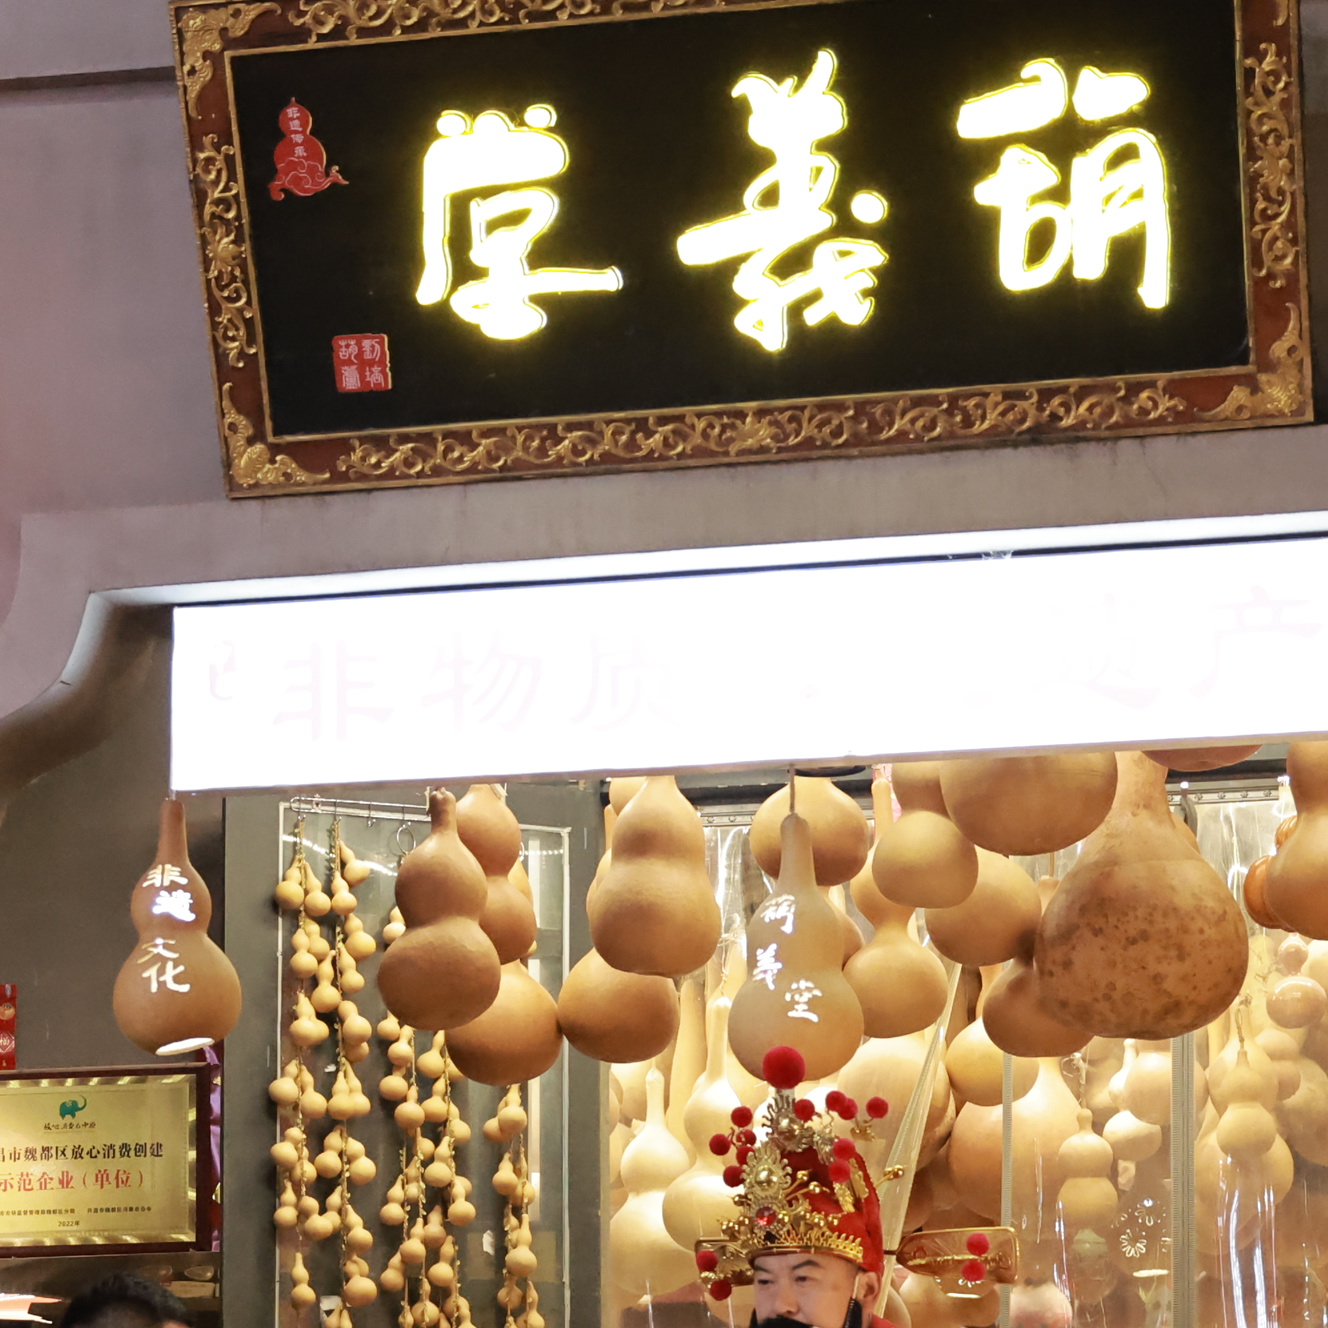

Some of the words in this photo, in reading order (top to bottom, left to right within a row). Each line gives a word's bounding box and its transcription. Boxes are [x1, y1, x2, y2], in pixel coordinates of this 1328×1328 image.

[270, 584, 1324, 742] 非物质遗产
[57, 1219, 81, 1228] 2022年
